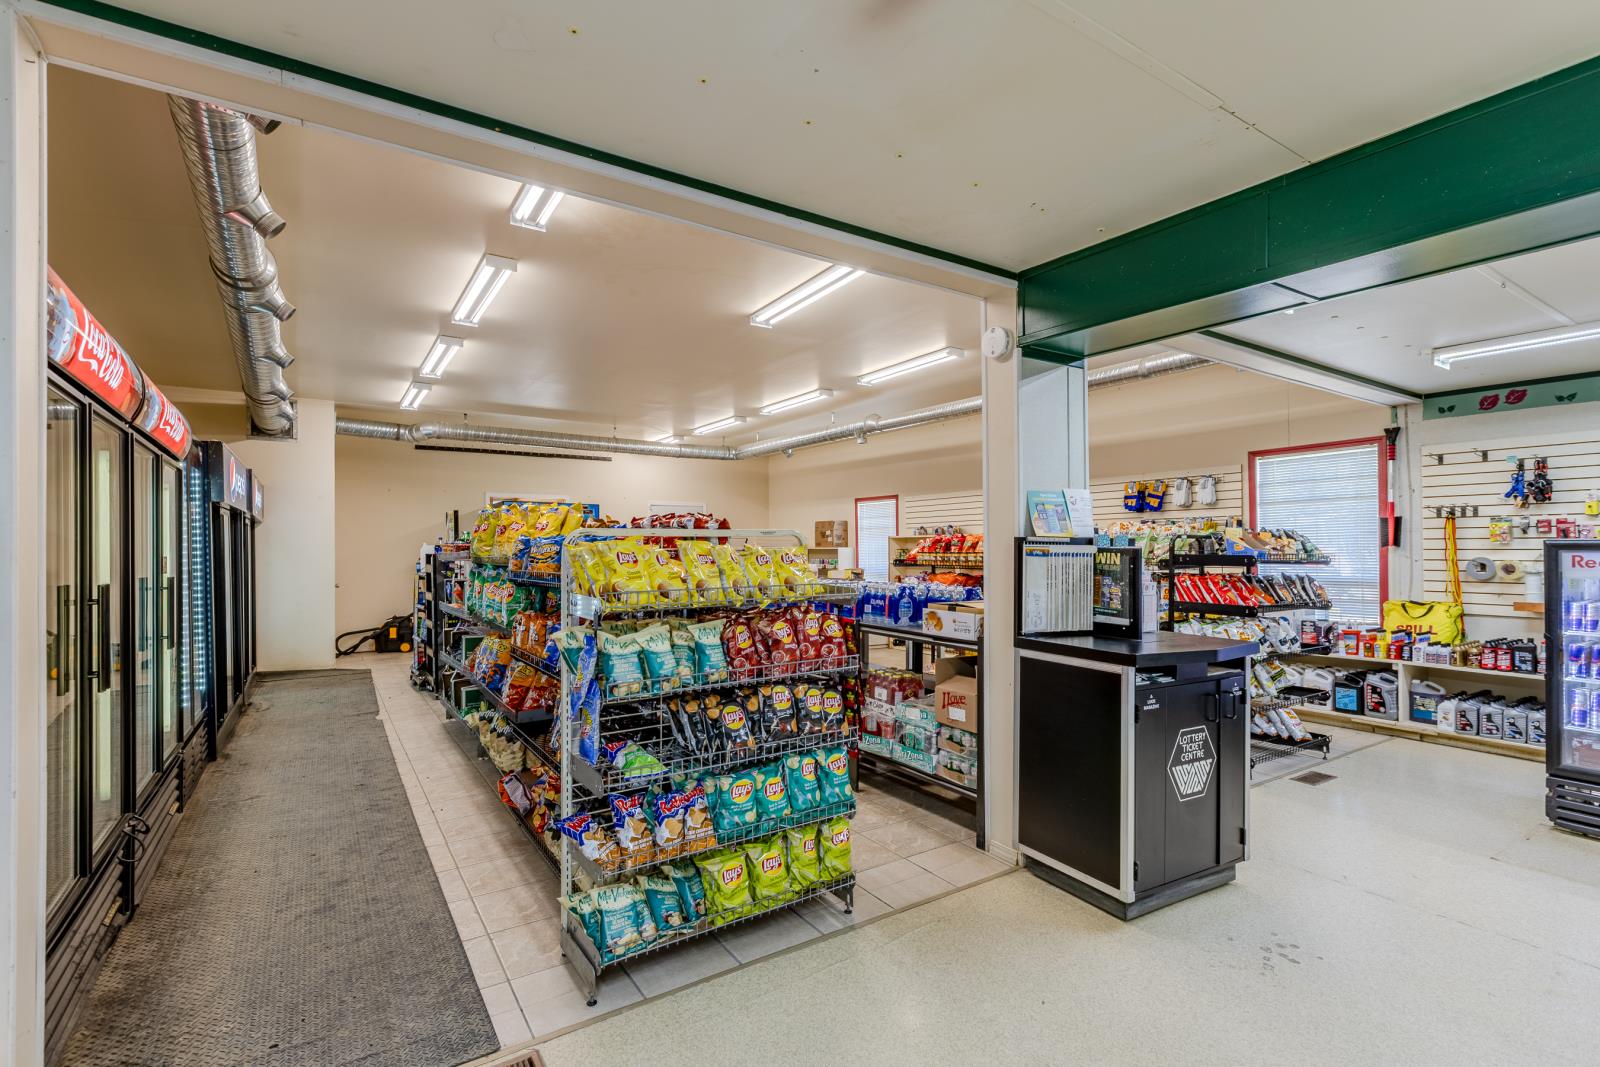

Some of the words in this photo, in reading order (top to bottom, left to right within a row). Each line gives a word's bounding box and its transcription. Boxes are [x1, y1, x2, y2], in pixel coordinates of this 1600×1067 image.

[1095, 552, 1121, 564] WIN
[1571, 555, 1600, 569] Re
[1179, 732, 1207, 745] LOTTERY
[1182, 741, 1204, 752] TICKET
[1181, 749, 1205, 762] CENTRE
